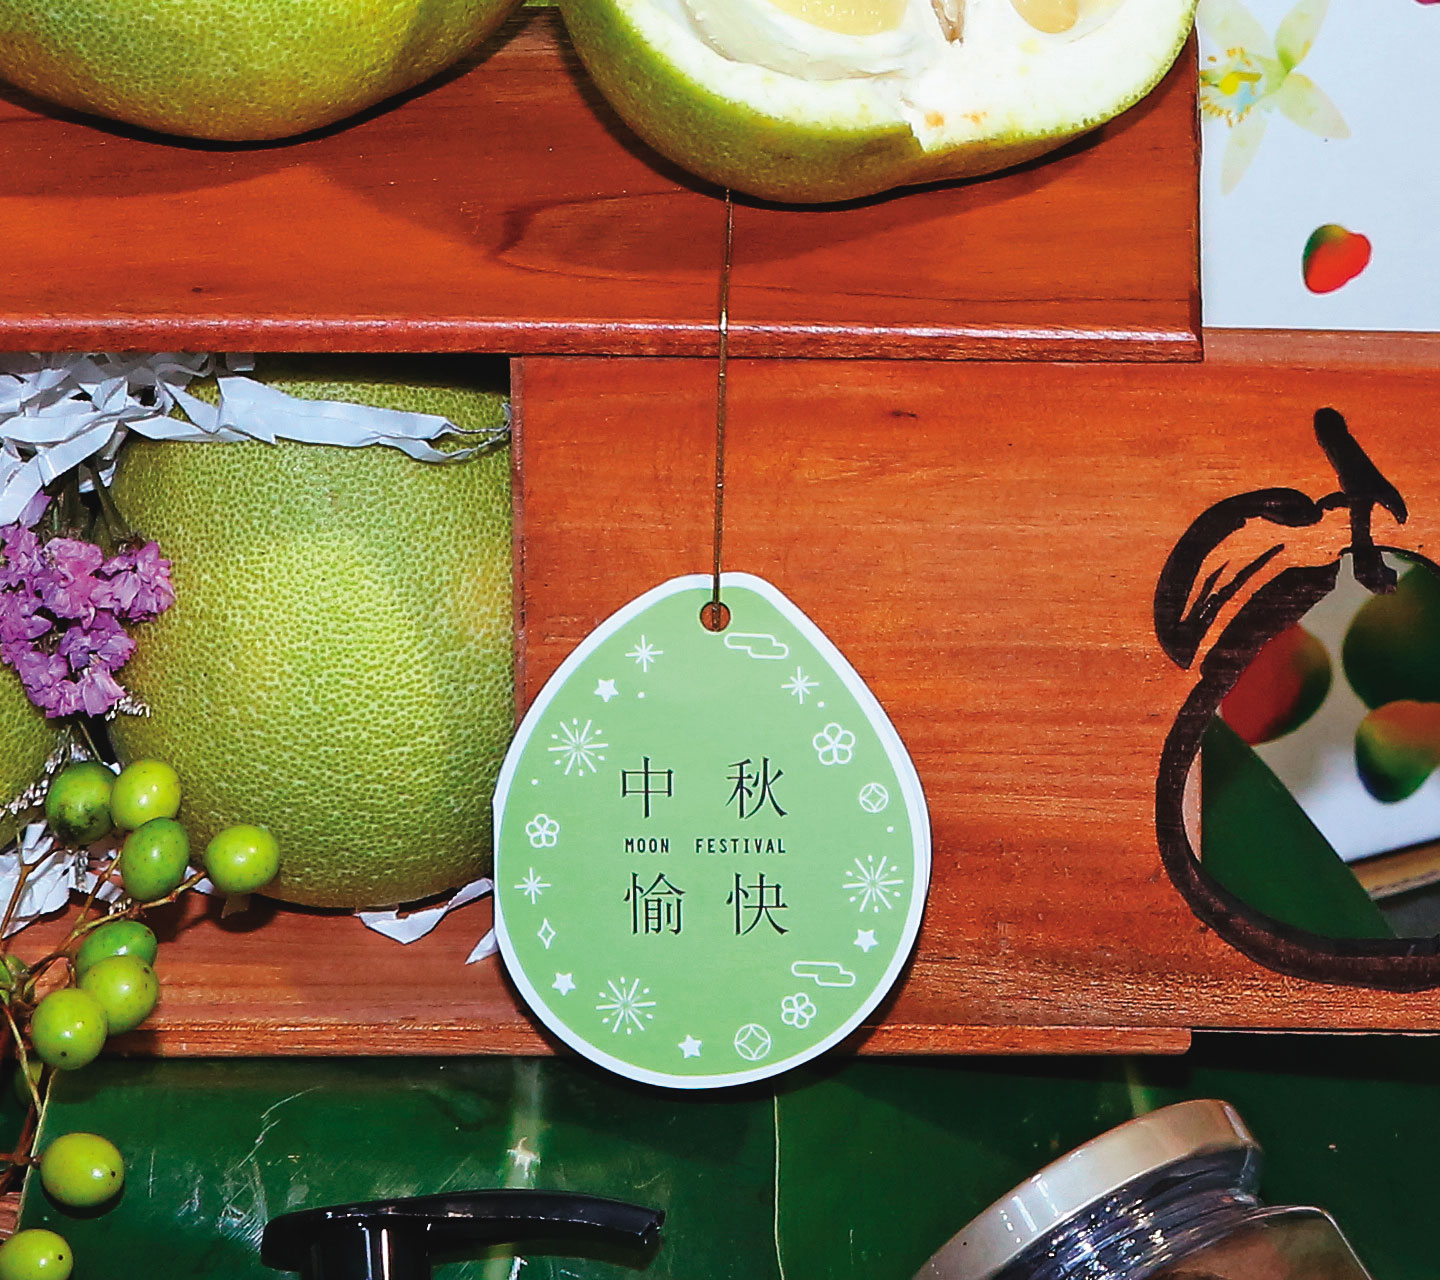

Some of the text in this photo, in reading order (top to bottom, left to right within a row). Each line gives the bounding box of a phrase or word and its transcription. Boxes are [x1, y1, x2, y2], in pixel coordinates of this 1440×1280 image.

[620, 755, 789, 821] 中秋
[623, 837, 787, 855] MOON FESTIVAL
[622, 871, 790, 937] 愉快
